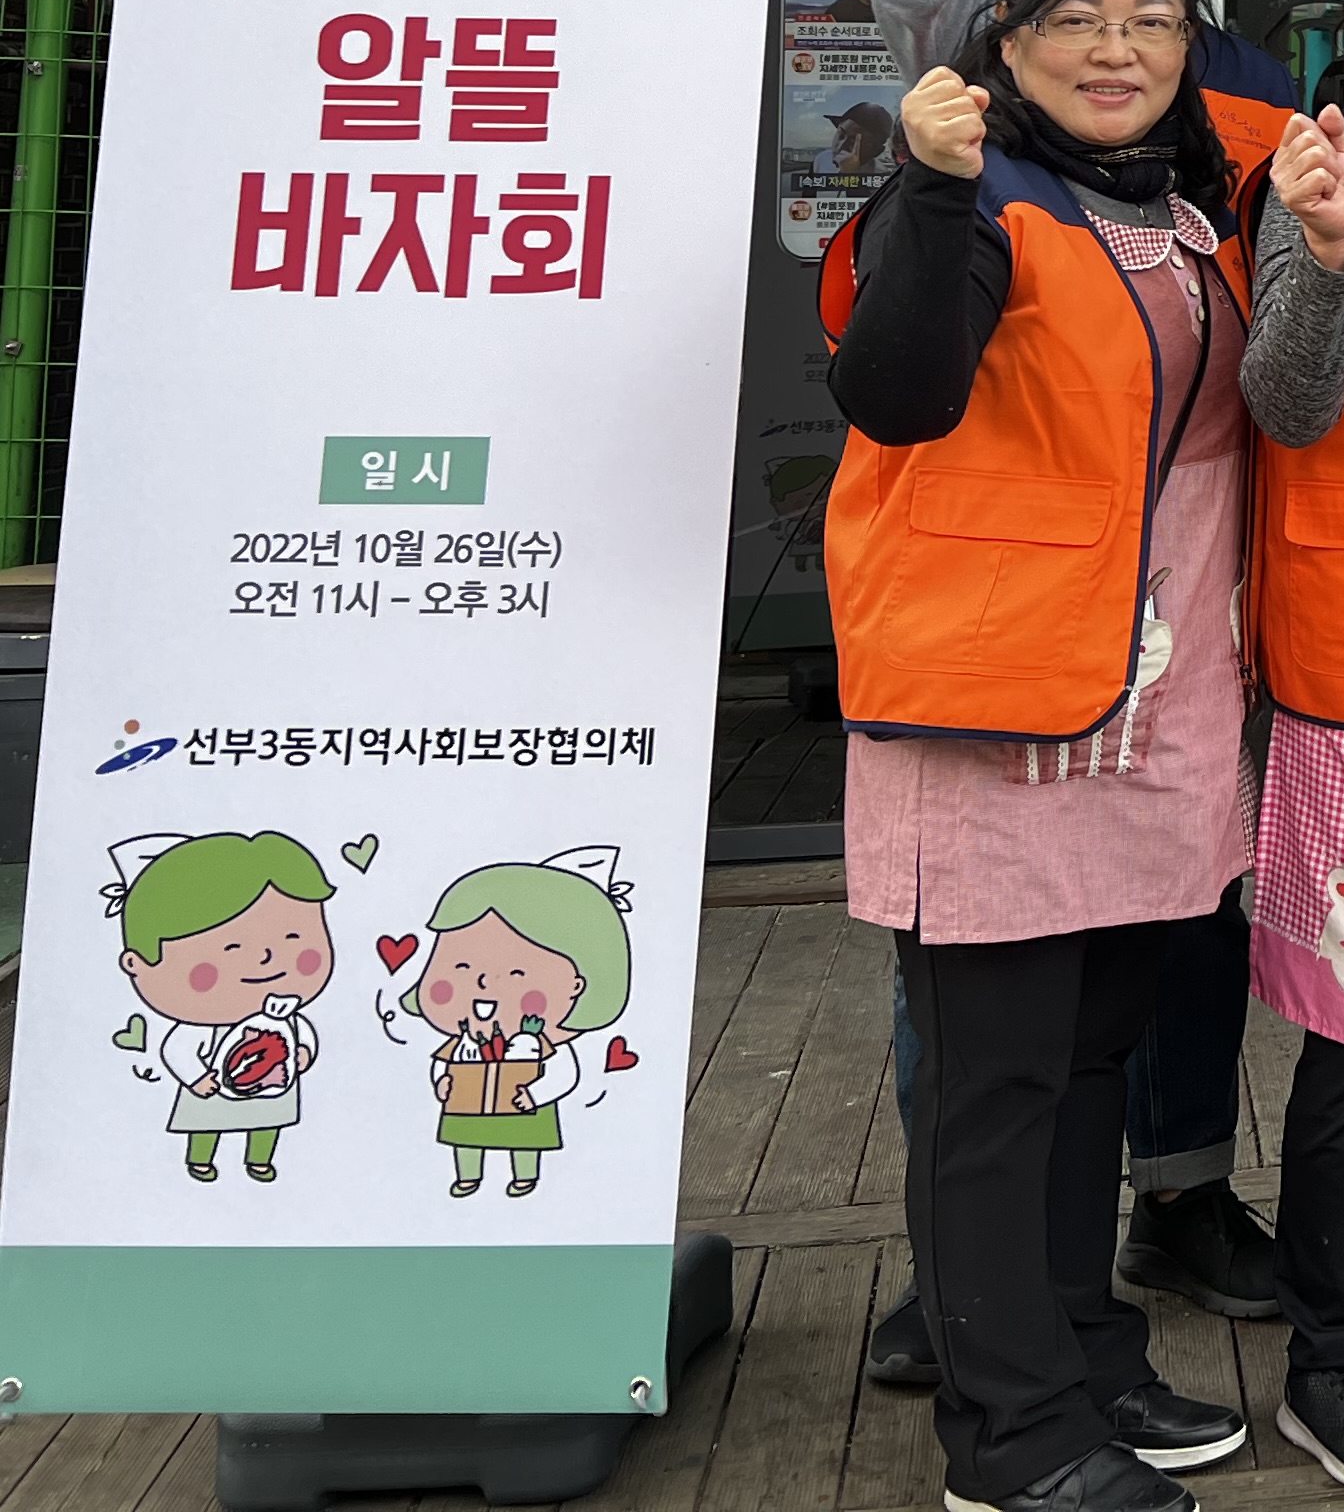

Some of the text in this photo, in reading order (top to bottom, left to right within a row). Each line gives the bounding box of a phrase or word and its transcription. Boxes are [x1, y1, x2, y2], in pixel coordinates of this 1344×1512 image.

[797, 26, 872, 37] 조회수 순서대로
[316, 13, 559, 142] 알뜰
[828, 175, 860, 188] 자세한
[230, 170, 612, 300] 바자회
[360, 451, 452, 491] 일 시
[230, 530, 563, 569] 2022년 10월 26일(수)
[229, 579, 298, 618] 오전
[312, 579, 381, 618] 11시
[418, 579, 489, 618] 오후
[497, 579, 551, 618] 3시
[182, 725, 656, 769] 선부3동지역사회보장협의체
